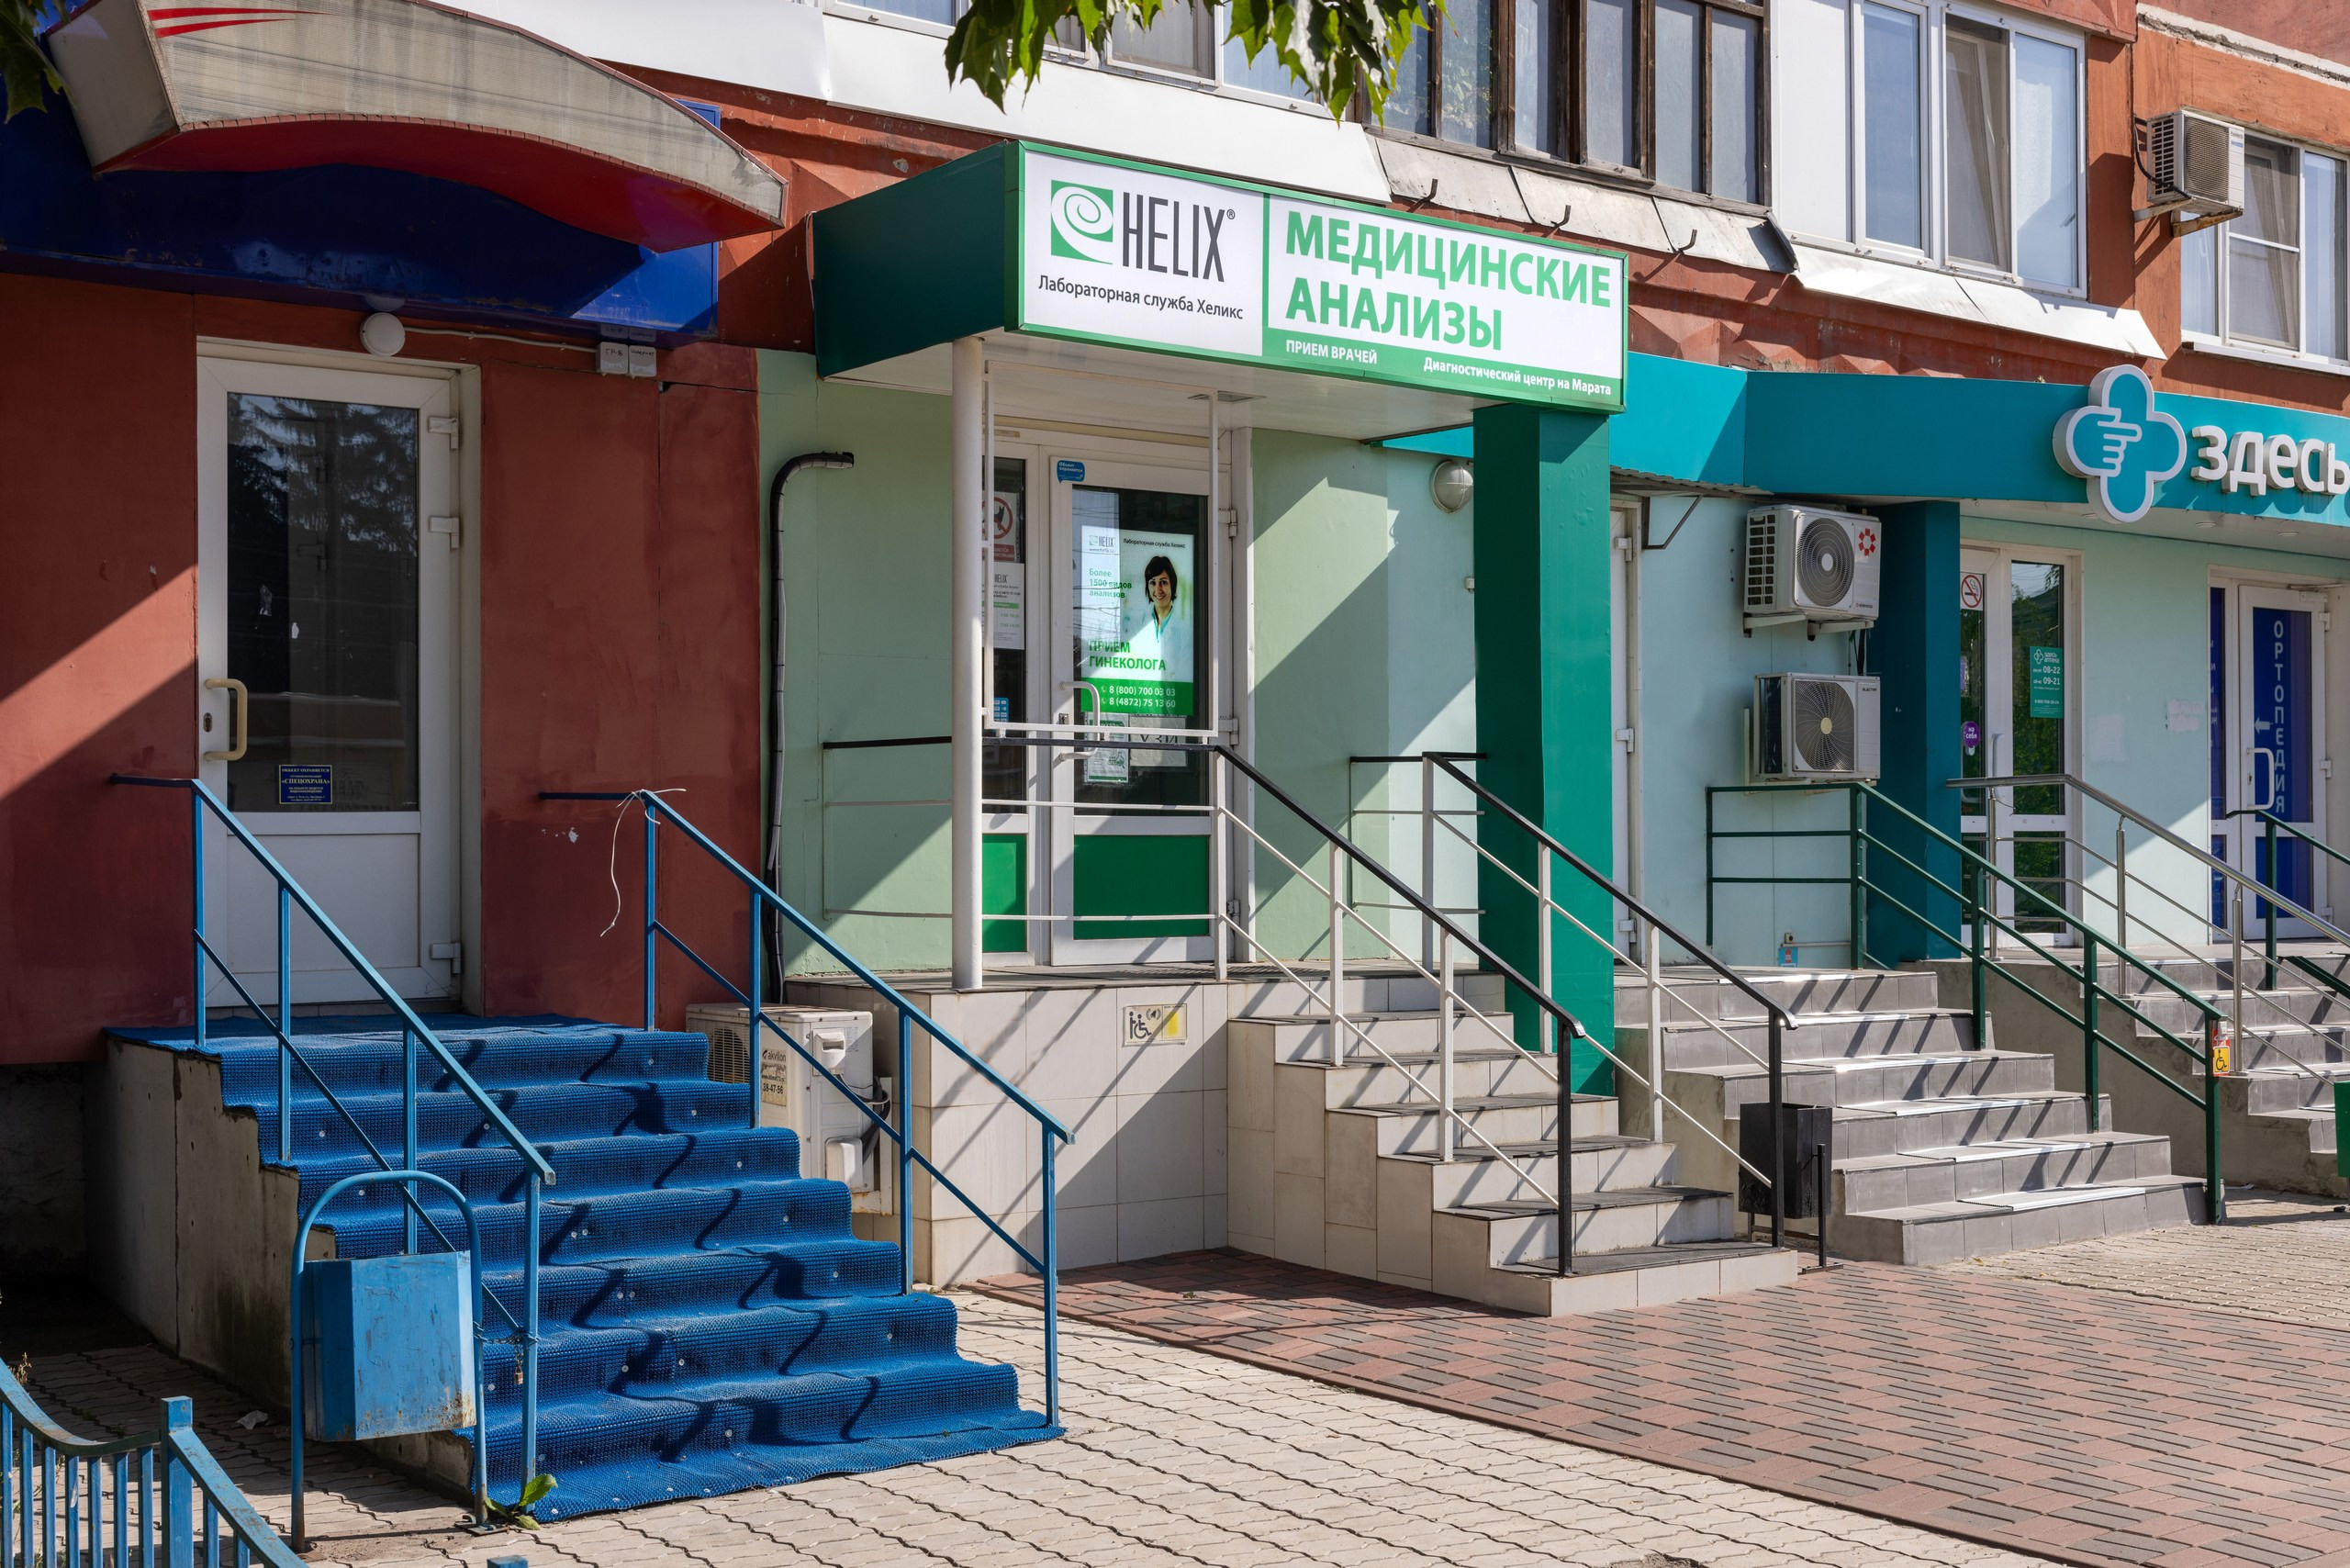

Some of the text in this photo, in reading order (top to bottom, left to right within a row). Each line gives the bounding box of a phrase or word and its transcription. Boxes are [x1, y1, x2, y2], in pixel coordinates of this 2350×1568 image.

[1286, 210, 1611, 308] МЕДИЦИНСКИЕ
[1038, 274, 1243, 319] Лабораторная служба Хеликс
[1285, 276, 1503, 351] АНАЛИЗЫ
[1286, 340, 1378, 364] ПРИЕМ ВРАЧЕЙ
[1424, 357, 1611, 396] Диагностический центр на Марата
[1123, 538, 1155, 546] Лабораторная
[1089, 568, 1112, 577] Более
[1090, 578, 1107, 587] 1500
[1089, 589, 1125, 599] анализов
[1089, 640, 1131, 653] ПРИЕМ
[1089, 655, 1167, 670] ГИНЕКОЛОГА
[1109, 685, 1175, 697] 8 (800) 700 03 03
[1116, 698, 1141, 707] (4872)
[1143, 699, 1153, 707] 75
[1166, 700, 1176, 708] 60
[2273, 620, 2286, 813] ОРТОПЕДИЯ
[767, 1050, 787, 1062] akvilon
